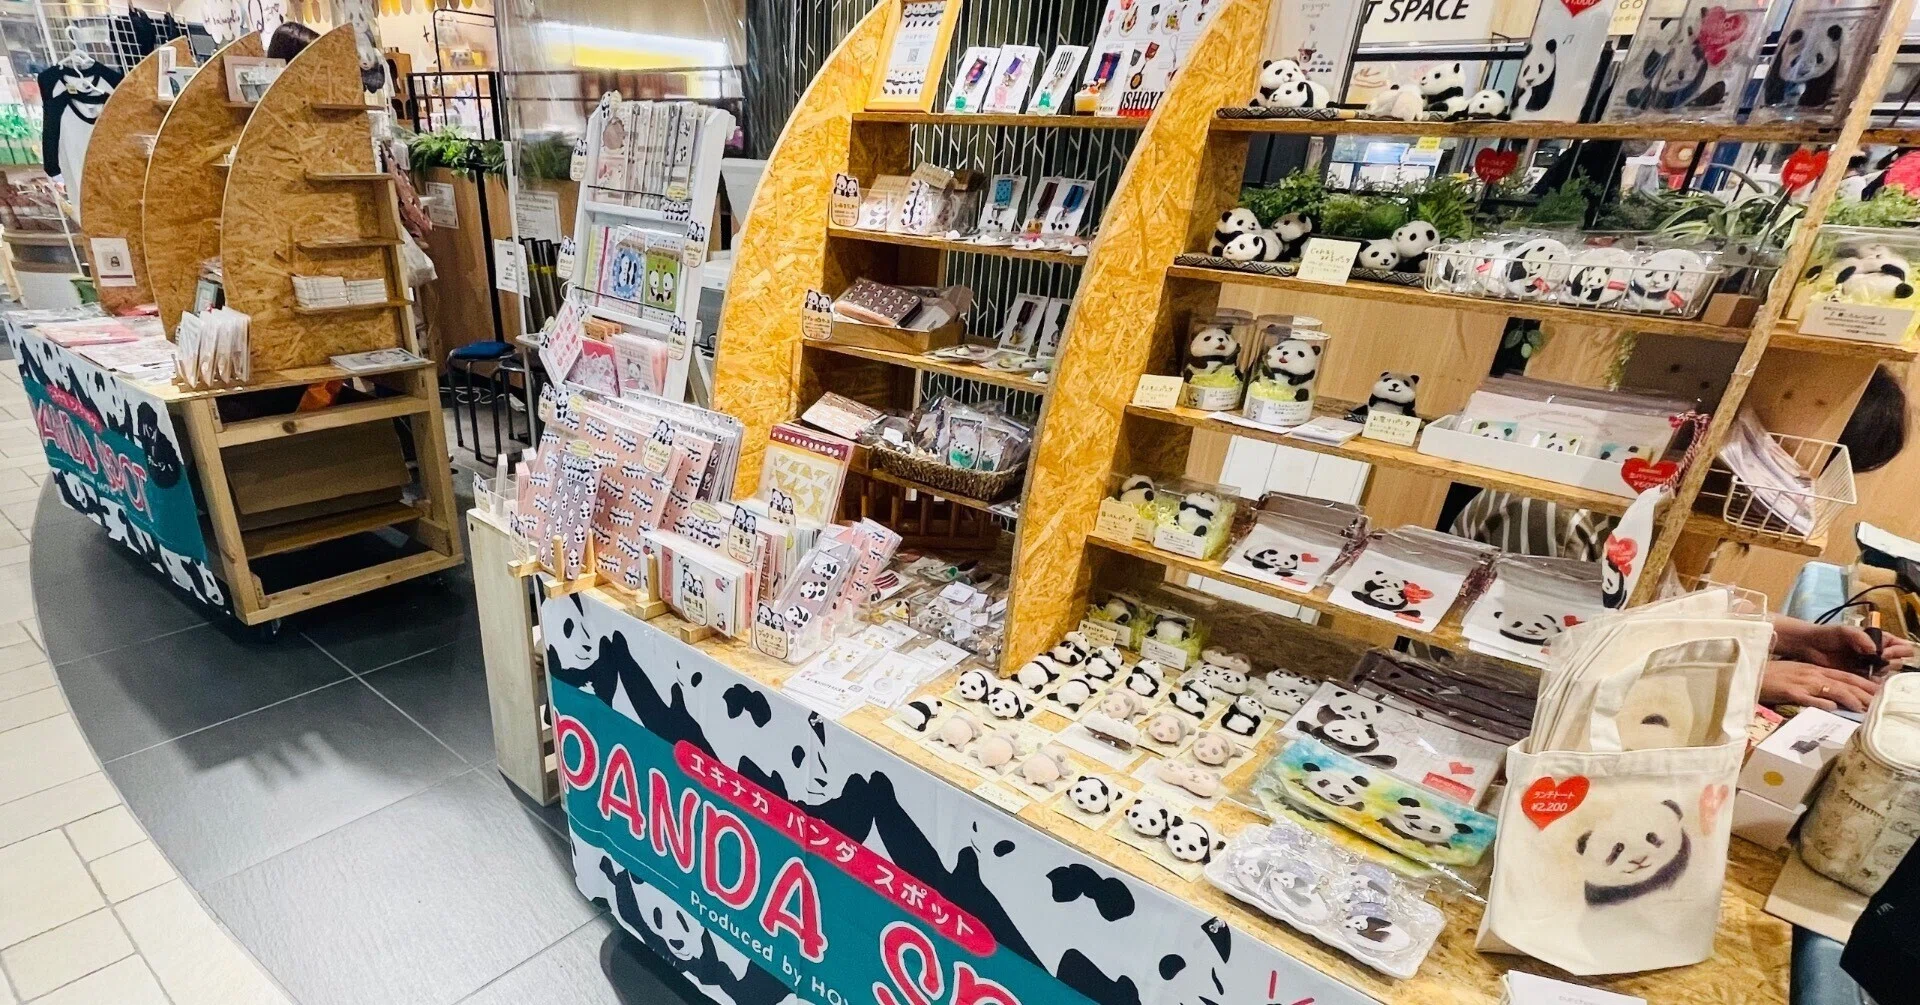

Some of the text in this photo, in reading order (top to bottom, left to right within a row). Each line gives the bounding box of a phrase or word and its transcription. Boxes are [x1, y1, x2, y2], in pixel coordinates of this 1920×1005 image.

[1383, 0, 1469, 23] SPACE
[553, 705, 828, 963] PANDA
[1533, 790, 1576, 800] ランチトート
[690, 753, 974, 937] エキナカ パンダ スポット
[690, 891, 773, 962] Produced
[782, 955, 802, 987] by
